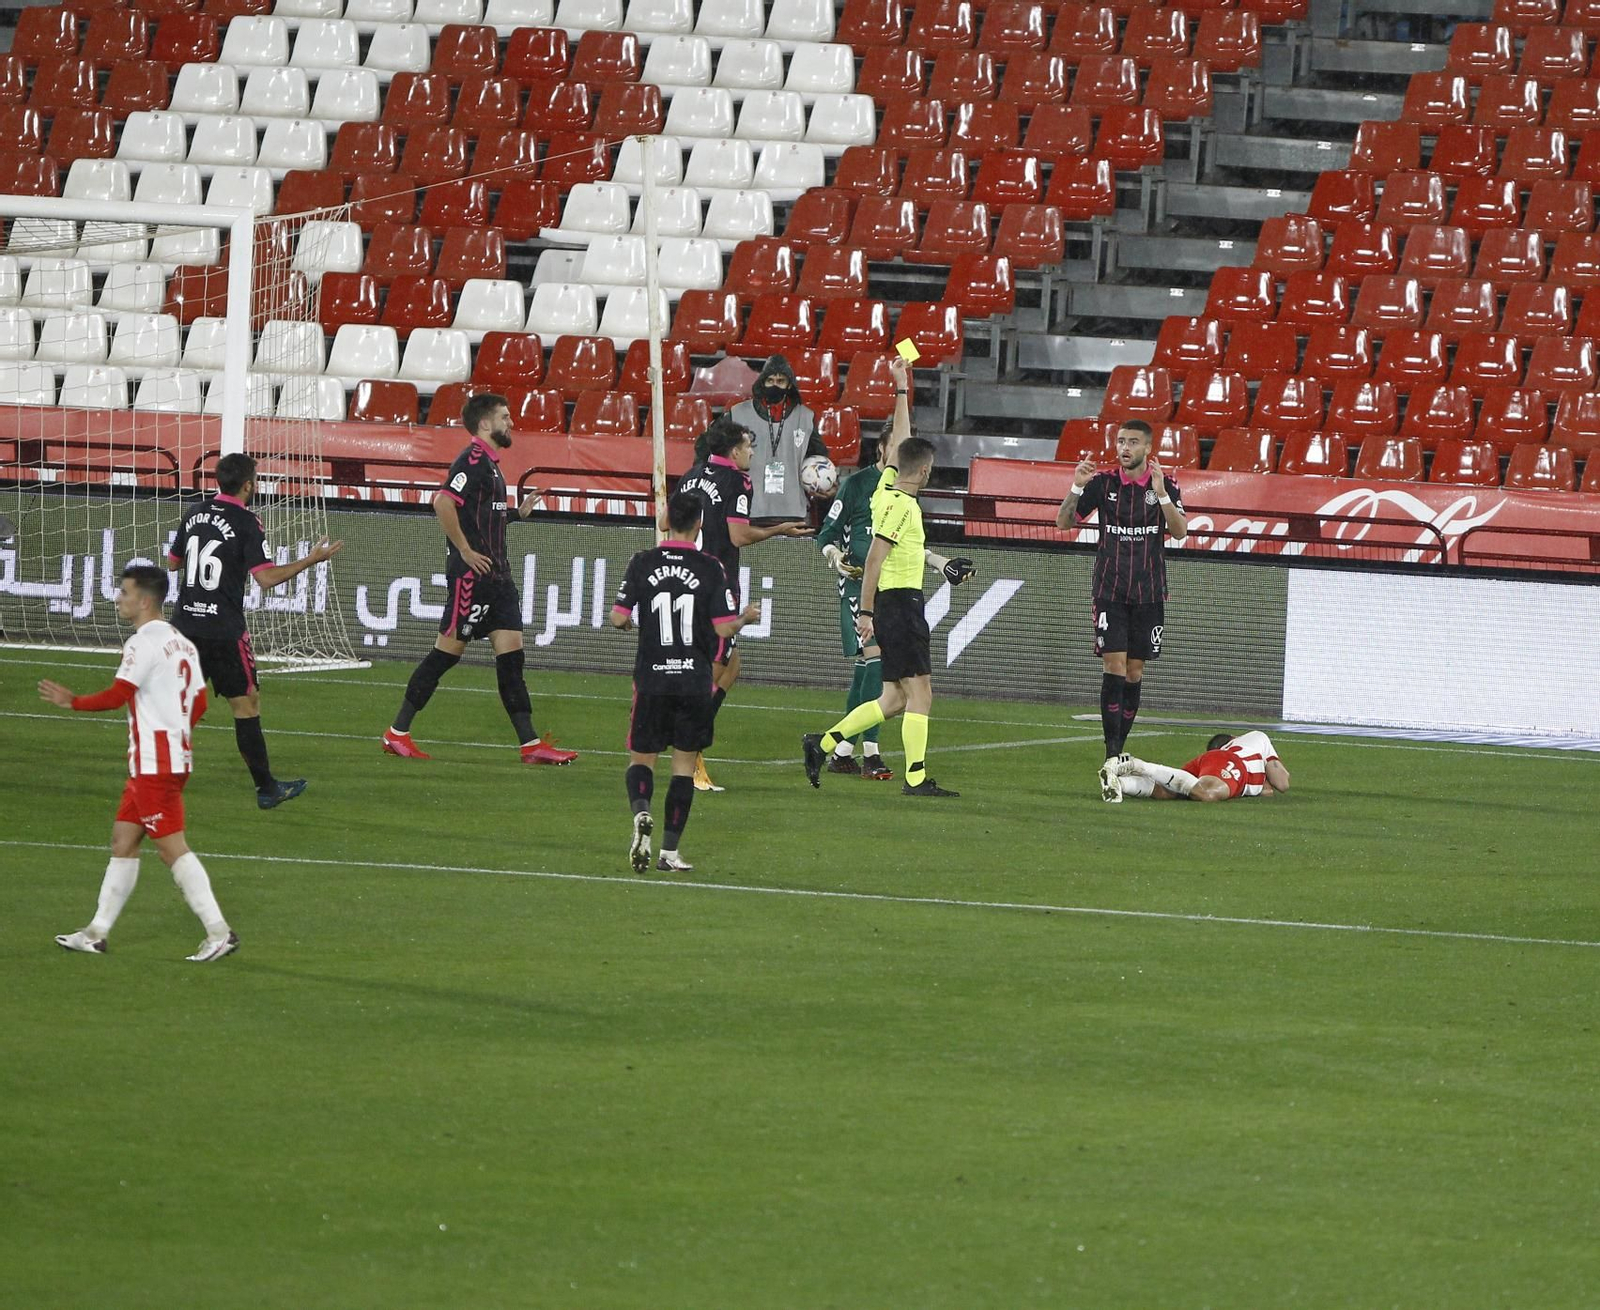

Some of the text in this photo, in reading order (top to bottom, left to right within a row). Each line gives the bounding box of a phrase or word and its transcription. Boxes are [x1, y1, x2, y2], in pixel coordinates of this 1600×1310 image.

[185, 513, 236, 540] AITOR SANZ
[1106, 525, 1159, 536] TENERIFE
[185, 535, 223, 591] 16
[647, 565, 700, 590] BERMEJO
[651, 592, 694, 646] 11
[1098, 611, 1109, 631] 4
